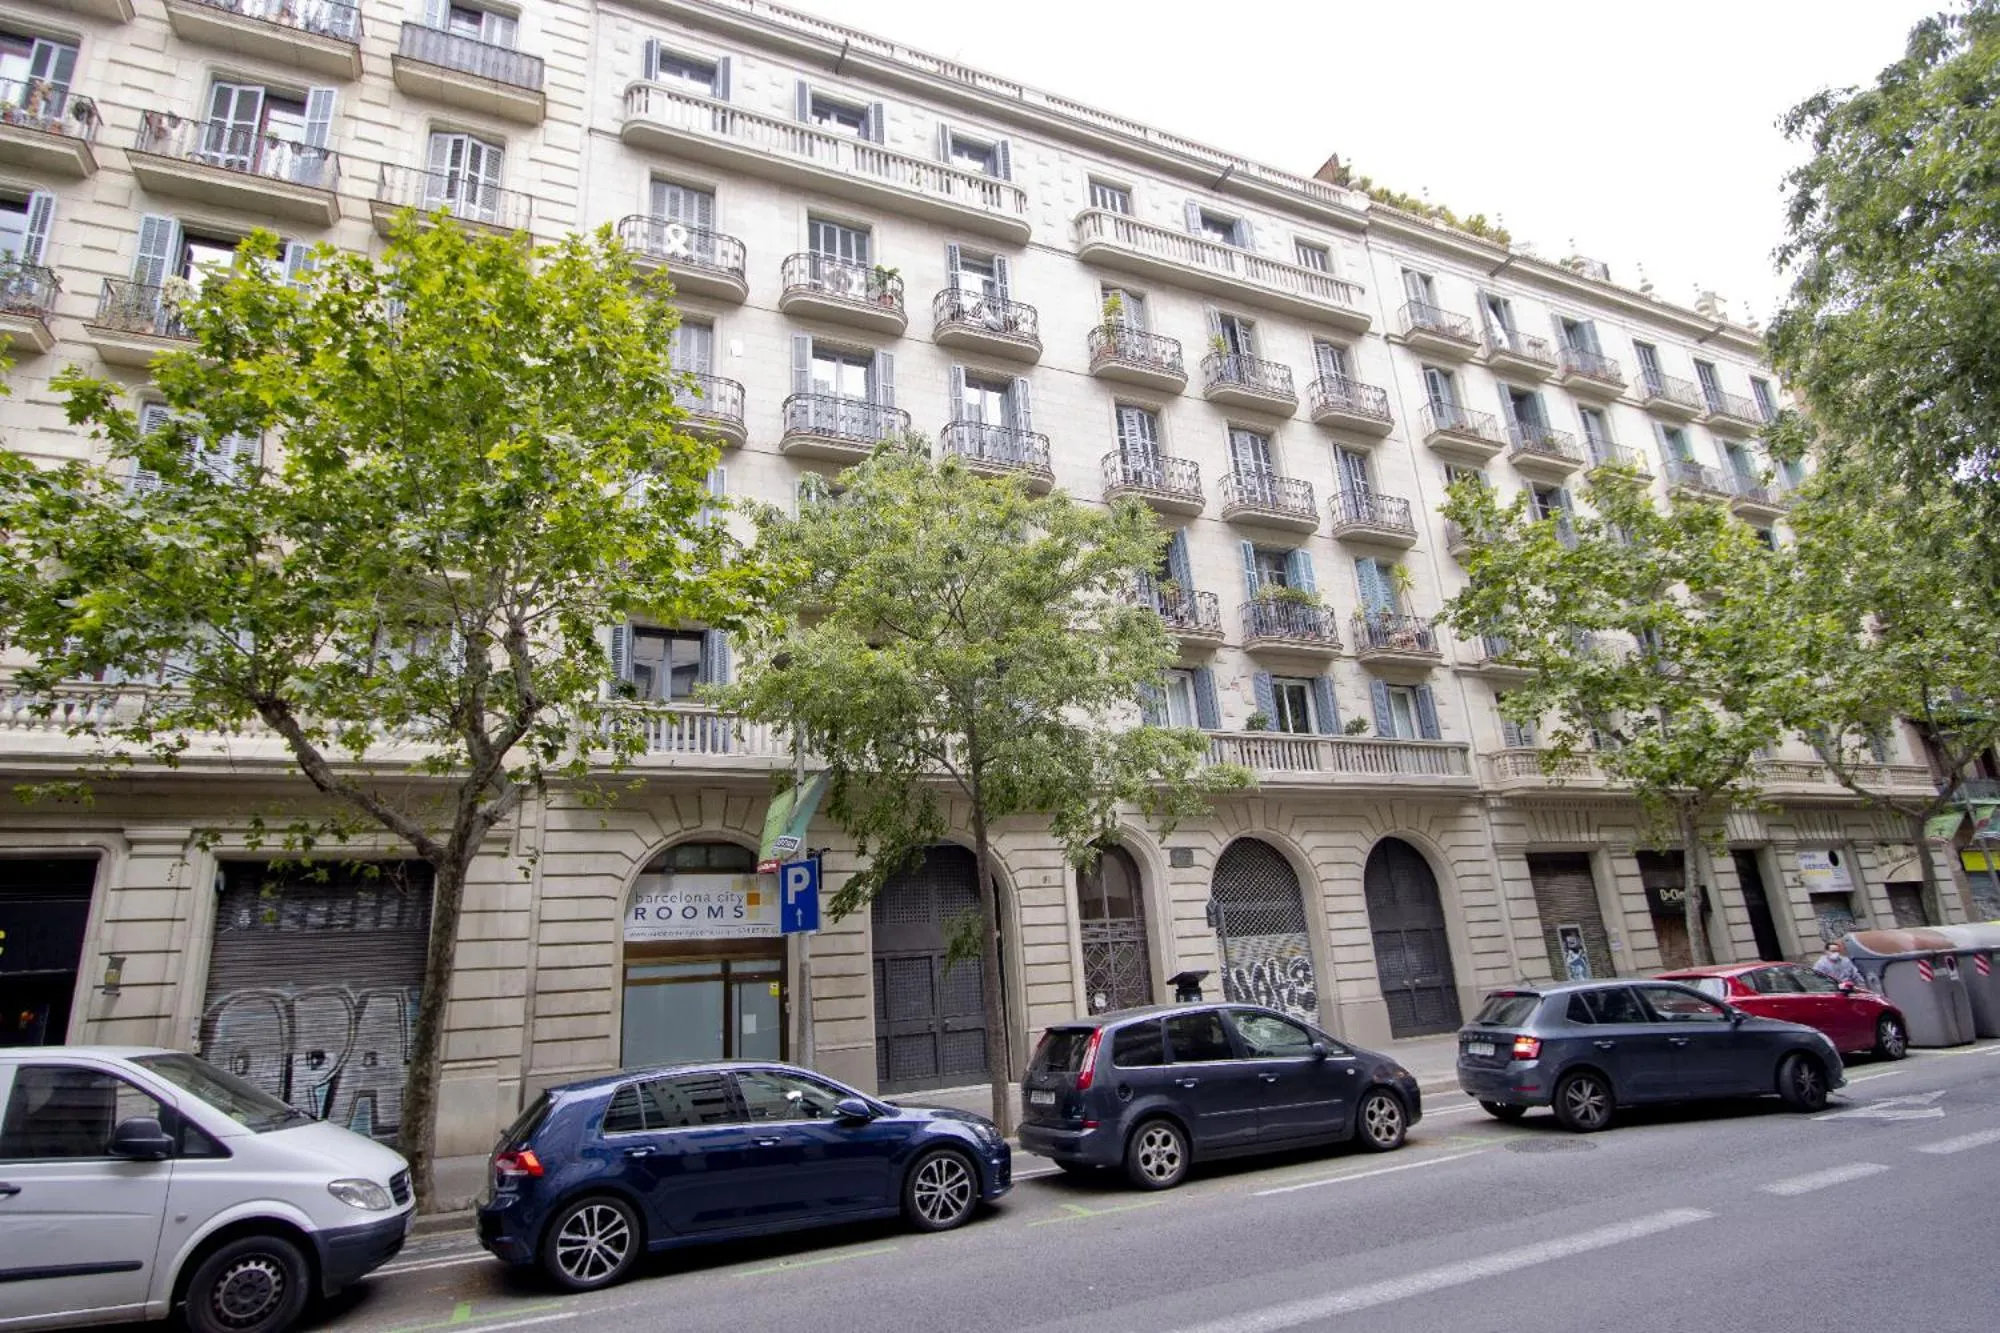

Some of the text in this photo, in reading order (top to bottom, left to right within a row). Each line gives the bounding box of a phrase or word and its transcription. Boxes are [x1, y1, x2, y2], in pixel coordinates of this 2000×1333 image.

[787, 866, 811, 905] P
[634, 890, 744, 907] barcelona city
[634, 905, 744, 920] ROOMS
